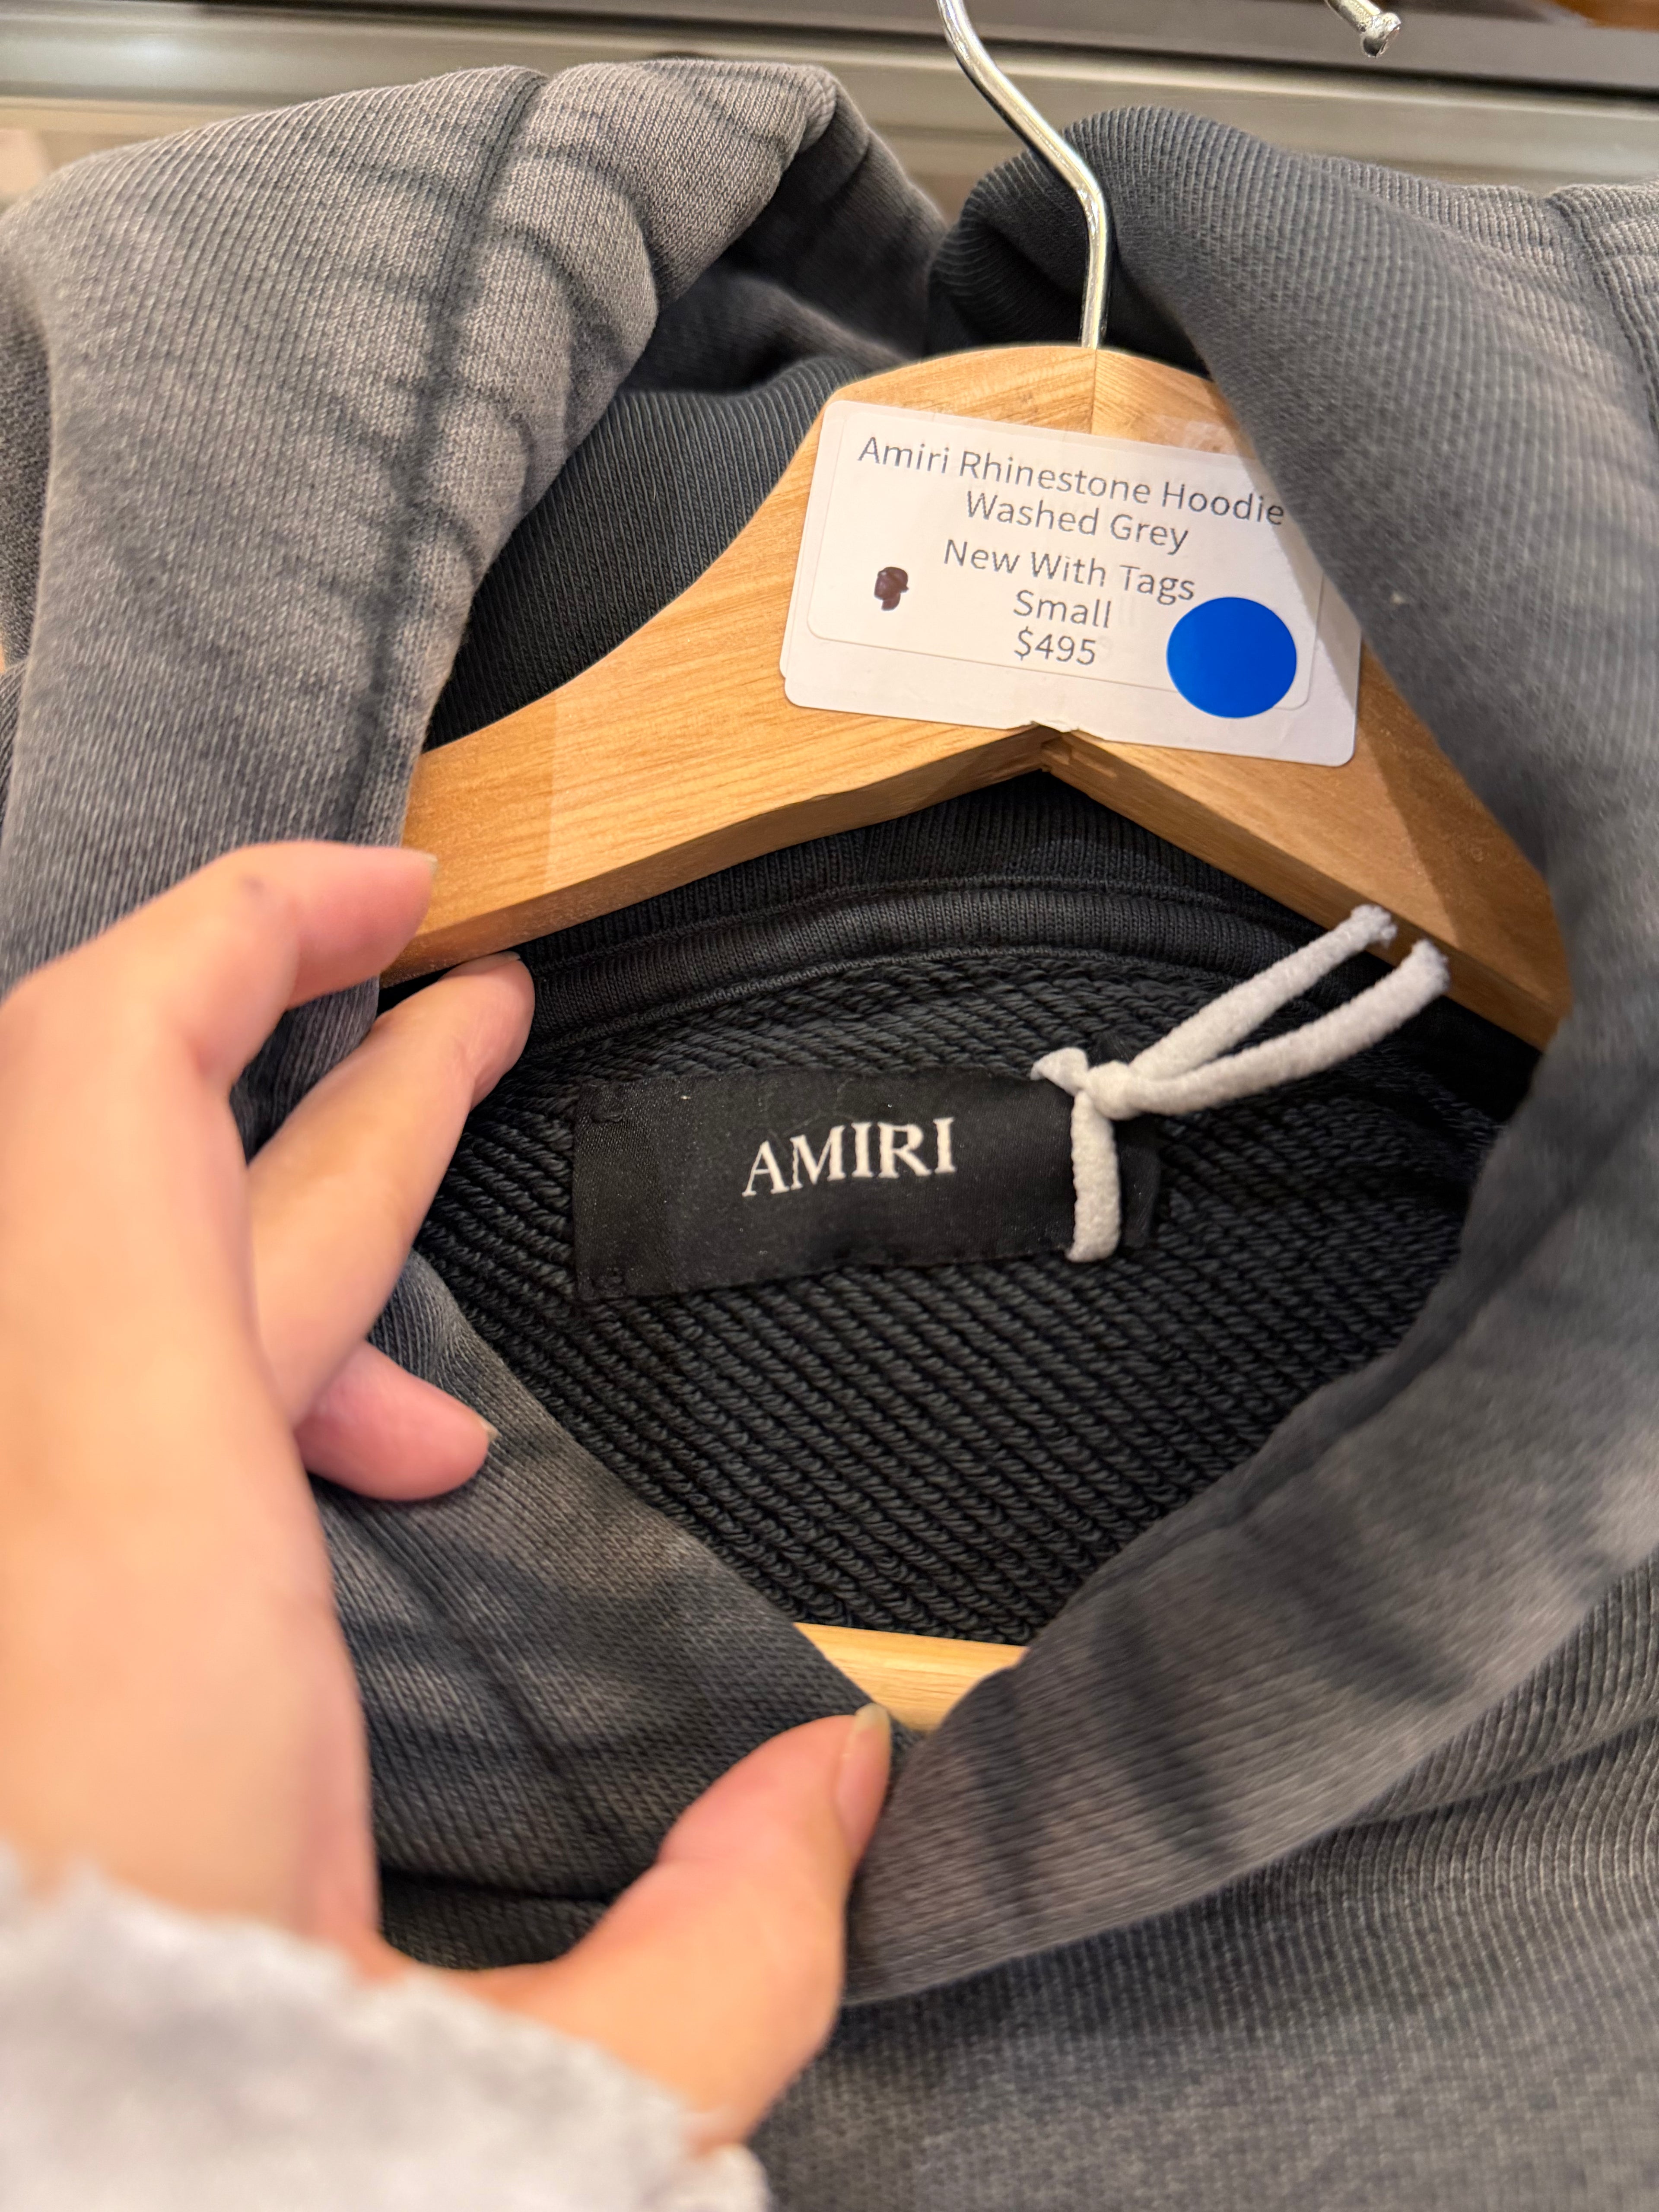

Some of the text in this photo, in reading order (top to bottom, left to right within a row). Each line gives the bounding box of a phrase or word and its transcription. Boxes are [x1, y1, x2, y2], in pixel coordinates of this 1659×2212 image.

[858, 435, 1284, 525] Amiri Rhinestone Hoodie
[966, 491, 1189, 556] Washed Grey
[944, 539, 1195, 605] New With Tags
[1013, 590, 1111, 629] Small
[1014, 626, 1096, 667] $495
[741, 1117, 956, 1197] AMIRI
